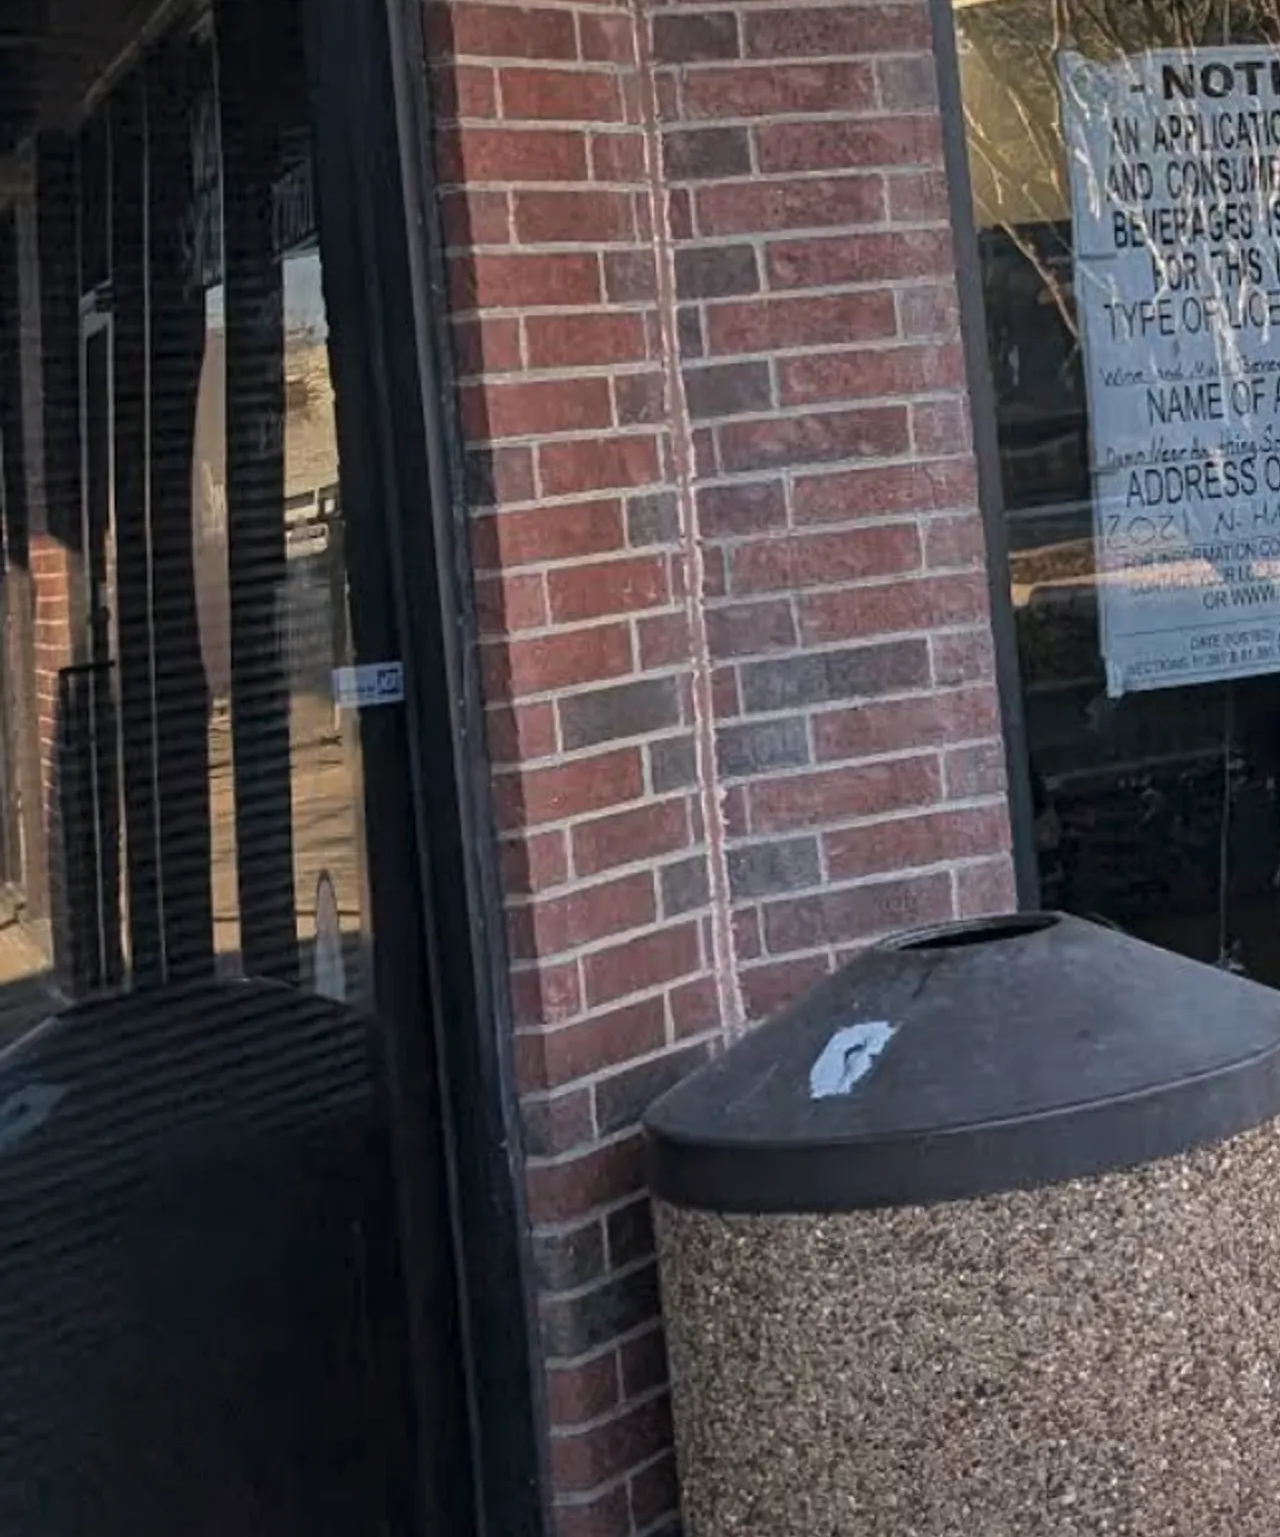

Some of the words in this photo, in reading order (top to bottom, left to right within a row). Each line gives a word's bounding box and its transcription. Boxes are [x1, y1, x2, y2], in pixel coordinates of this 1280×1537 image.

[1110, 117, 1140, 155] AN
[1107, 163, 1153, 202] AND
[1114, 203, 1252, 248] BEVERAGES
[1153, 253, 1198, 293] FOR
[1210, 247, 1262, 287] THIS
[1104, 298, 1175, 342] TYPE
[1182, 295, 1217, 334] OF
[1145, 381, 1225, 426] NAME
[1232, 378, 1265, 416] OF
[1125, 457, 1257, 508] ADDRESS
